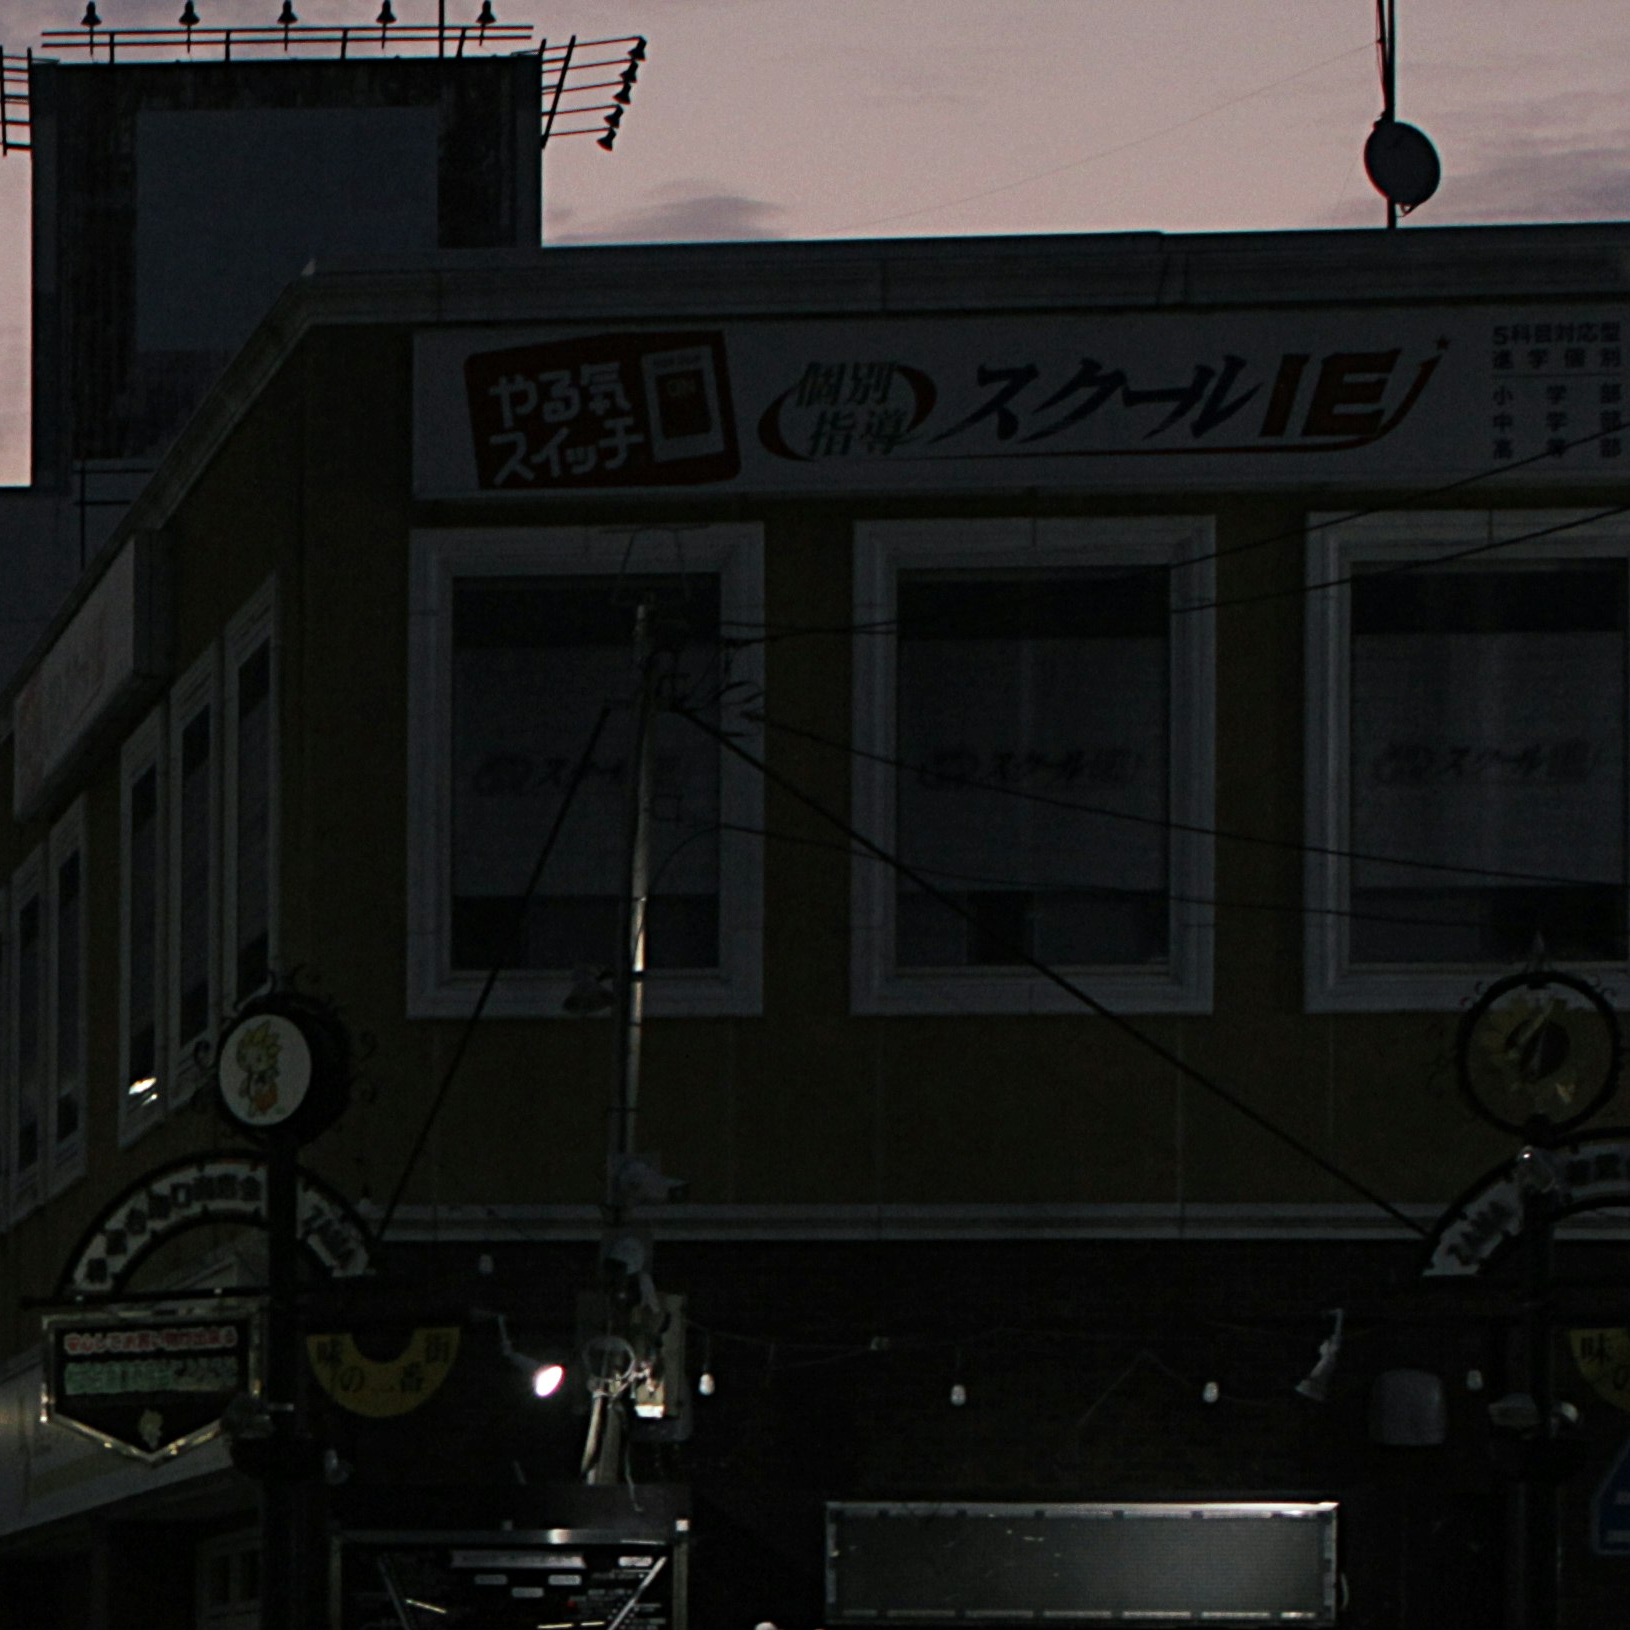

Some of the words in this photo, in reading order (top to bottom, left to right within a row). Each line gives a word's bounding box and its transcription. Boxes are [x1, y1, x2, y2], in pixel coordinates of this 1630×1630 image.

[488, 361, 633, 429] やる気
[797, 361, 898, 408] 個別
[488, 416, 646, 487] スイッチ
[808, 409, 912, 457] 指導
